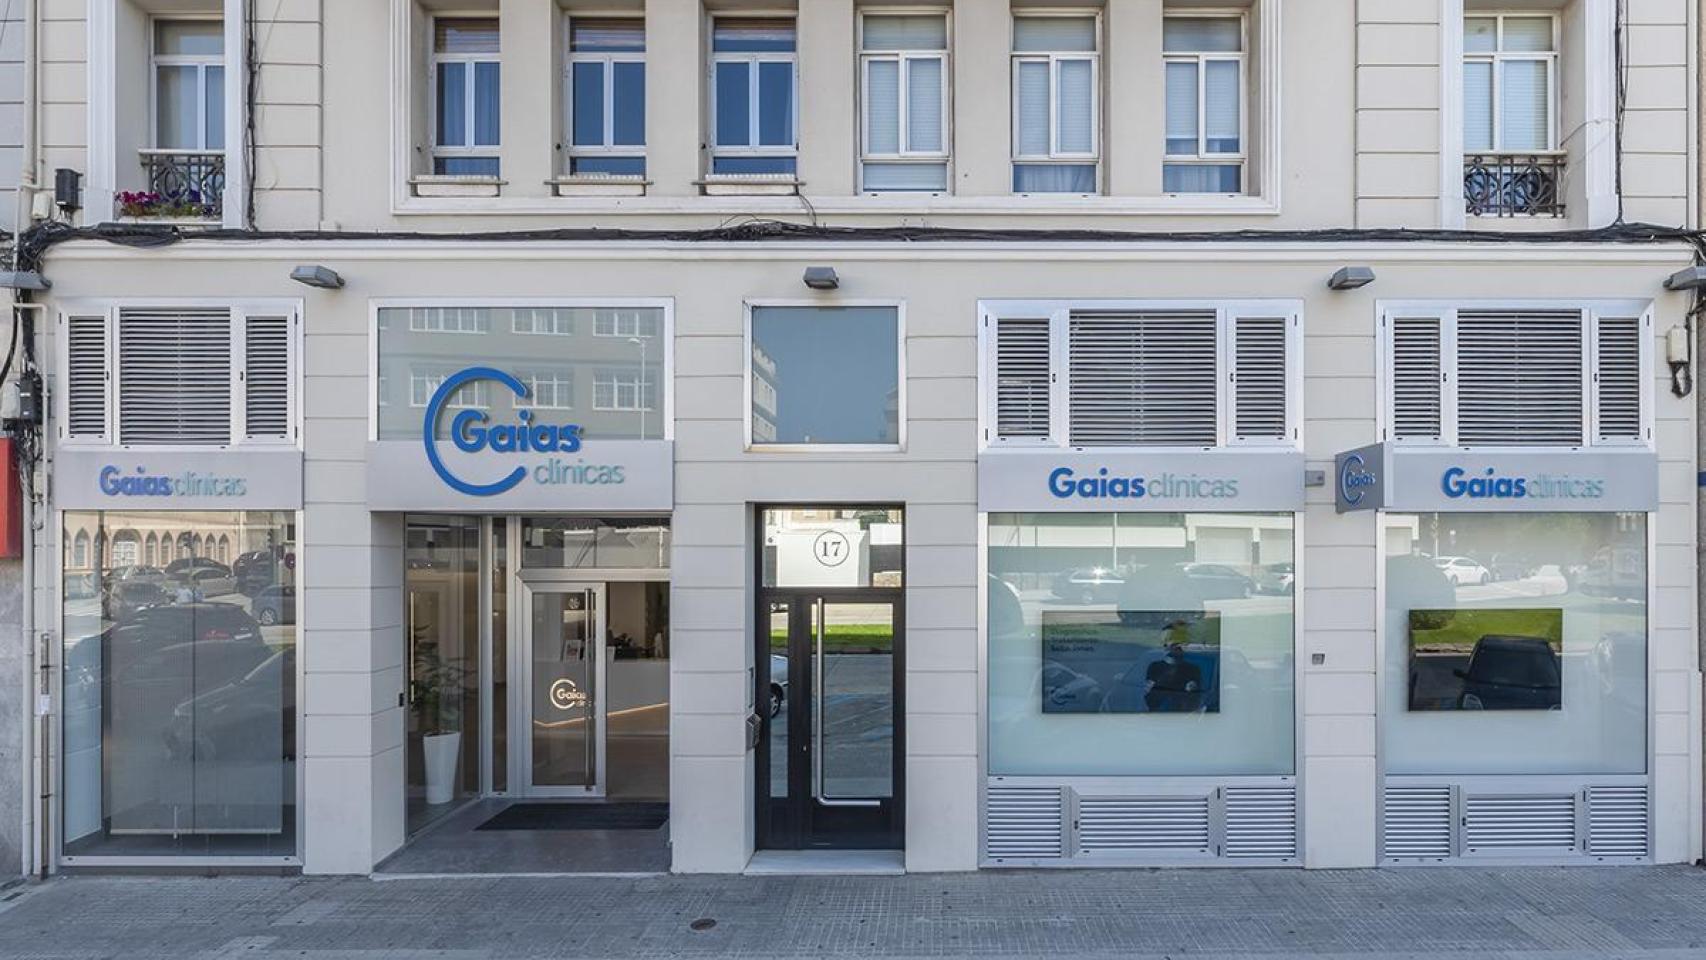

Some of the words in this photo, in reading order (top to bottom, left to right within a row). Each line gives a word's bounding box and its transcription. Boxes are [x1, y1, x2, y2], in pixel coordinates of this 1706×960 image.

[452, 408, 583, 453] Gaias
[100, 465, 173, 496] Gaias
[533, 459, 626, 485] clínicas
[1048, 467, 1146, 498] Gaias
[1147, 472, 1239, 498] clínicas
[1442, 467, 1526, 498] Gaias
[822, 541, 841, 557] 17
